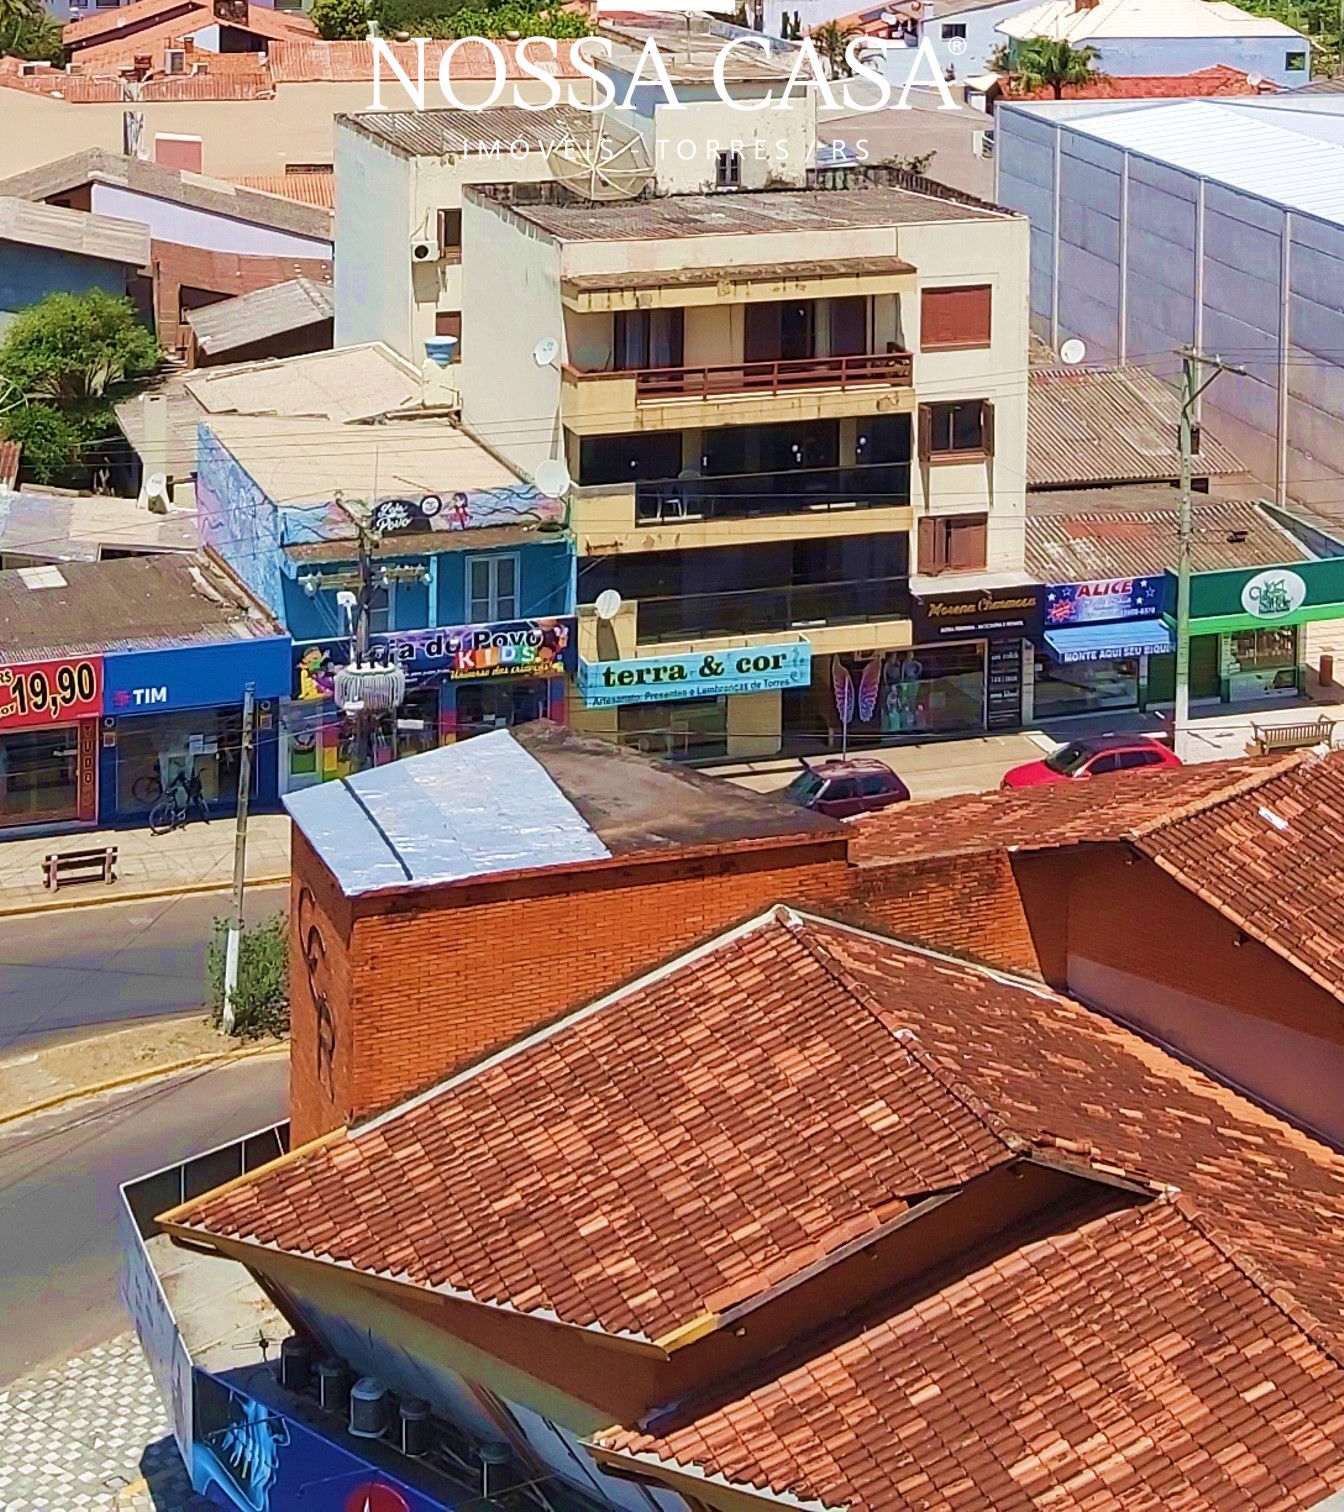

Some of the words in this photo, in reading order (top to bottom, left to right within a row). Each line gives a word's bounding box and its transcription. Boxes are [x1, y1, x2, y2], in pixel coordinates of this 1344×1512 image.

[1076, 580, 1133, 598] ALICE
[471, 629, 545, 649] Povo
[1064, 652, 1097, 663] MONTE
[1099, 649, 1122, 659] AQUI
[1123, 646, 1142, 657] SEU
[602, 664, 688, 688] terra
[698, 655, 725, 678] &
[735, 651, 788, 674] cor
[10, 661, 97, 719] 19,90
[132, 686, 168, 706] TIM
